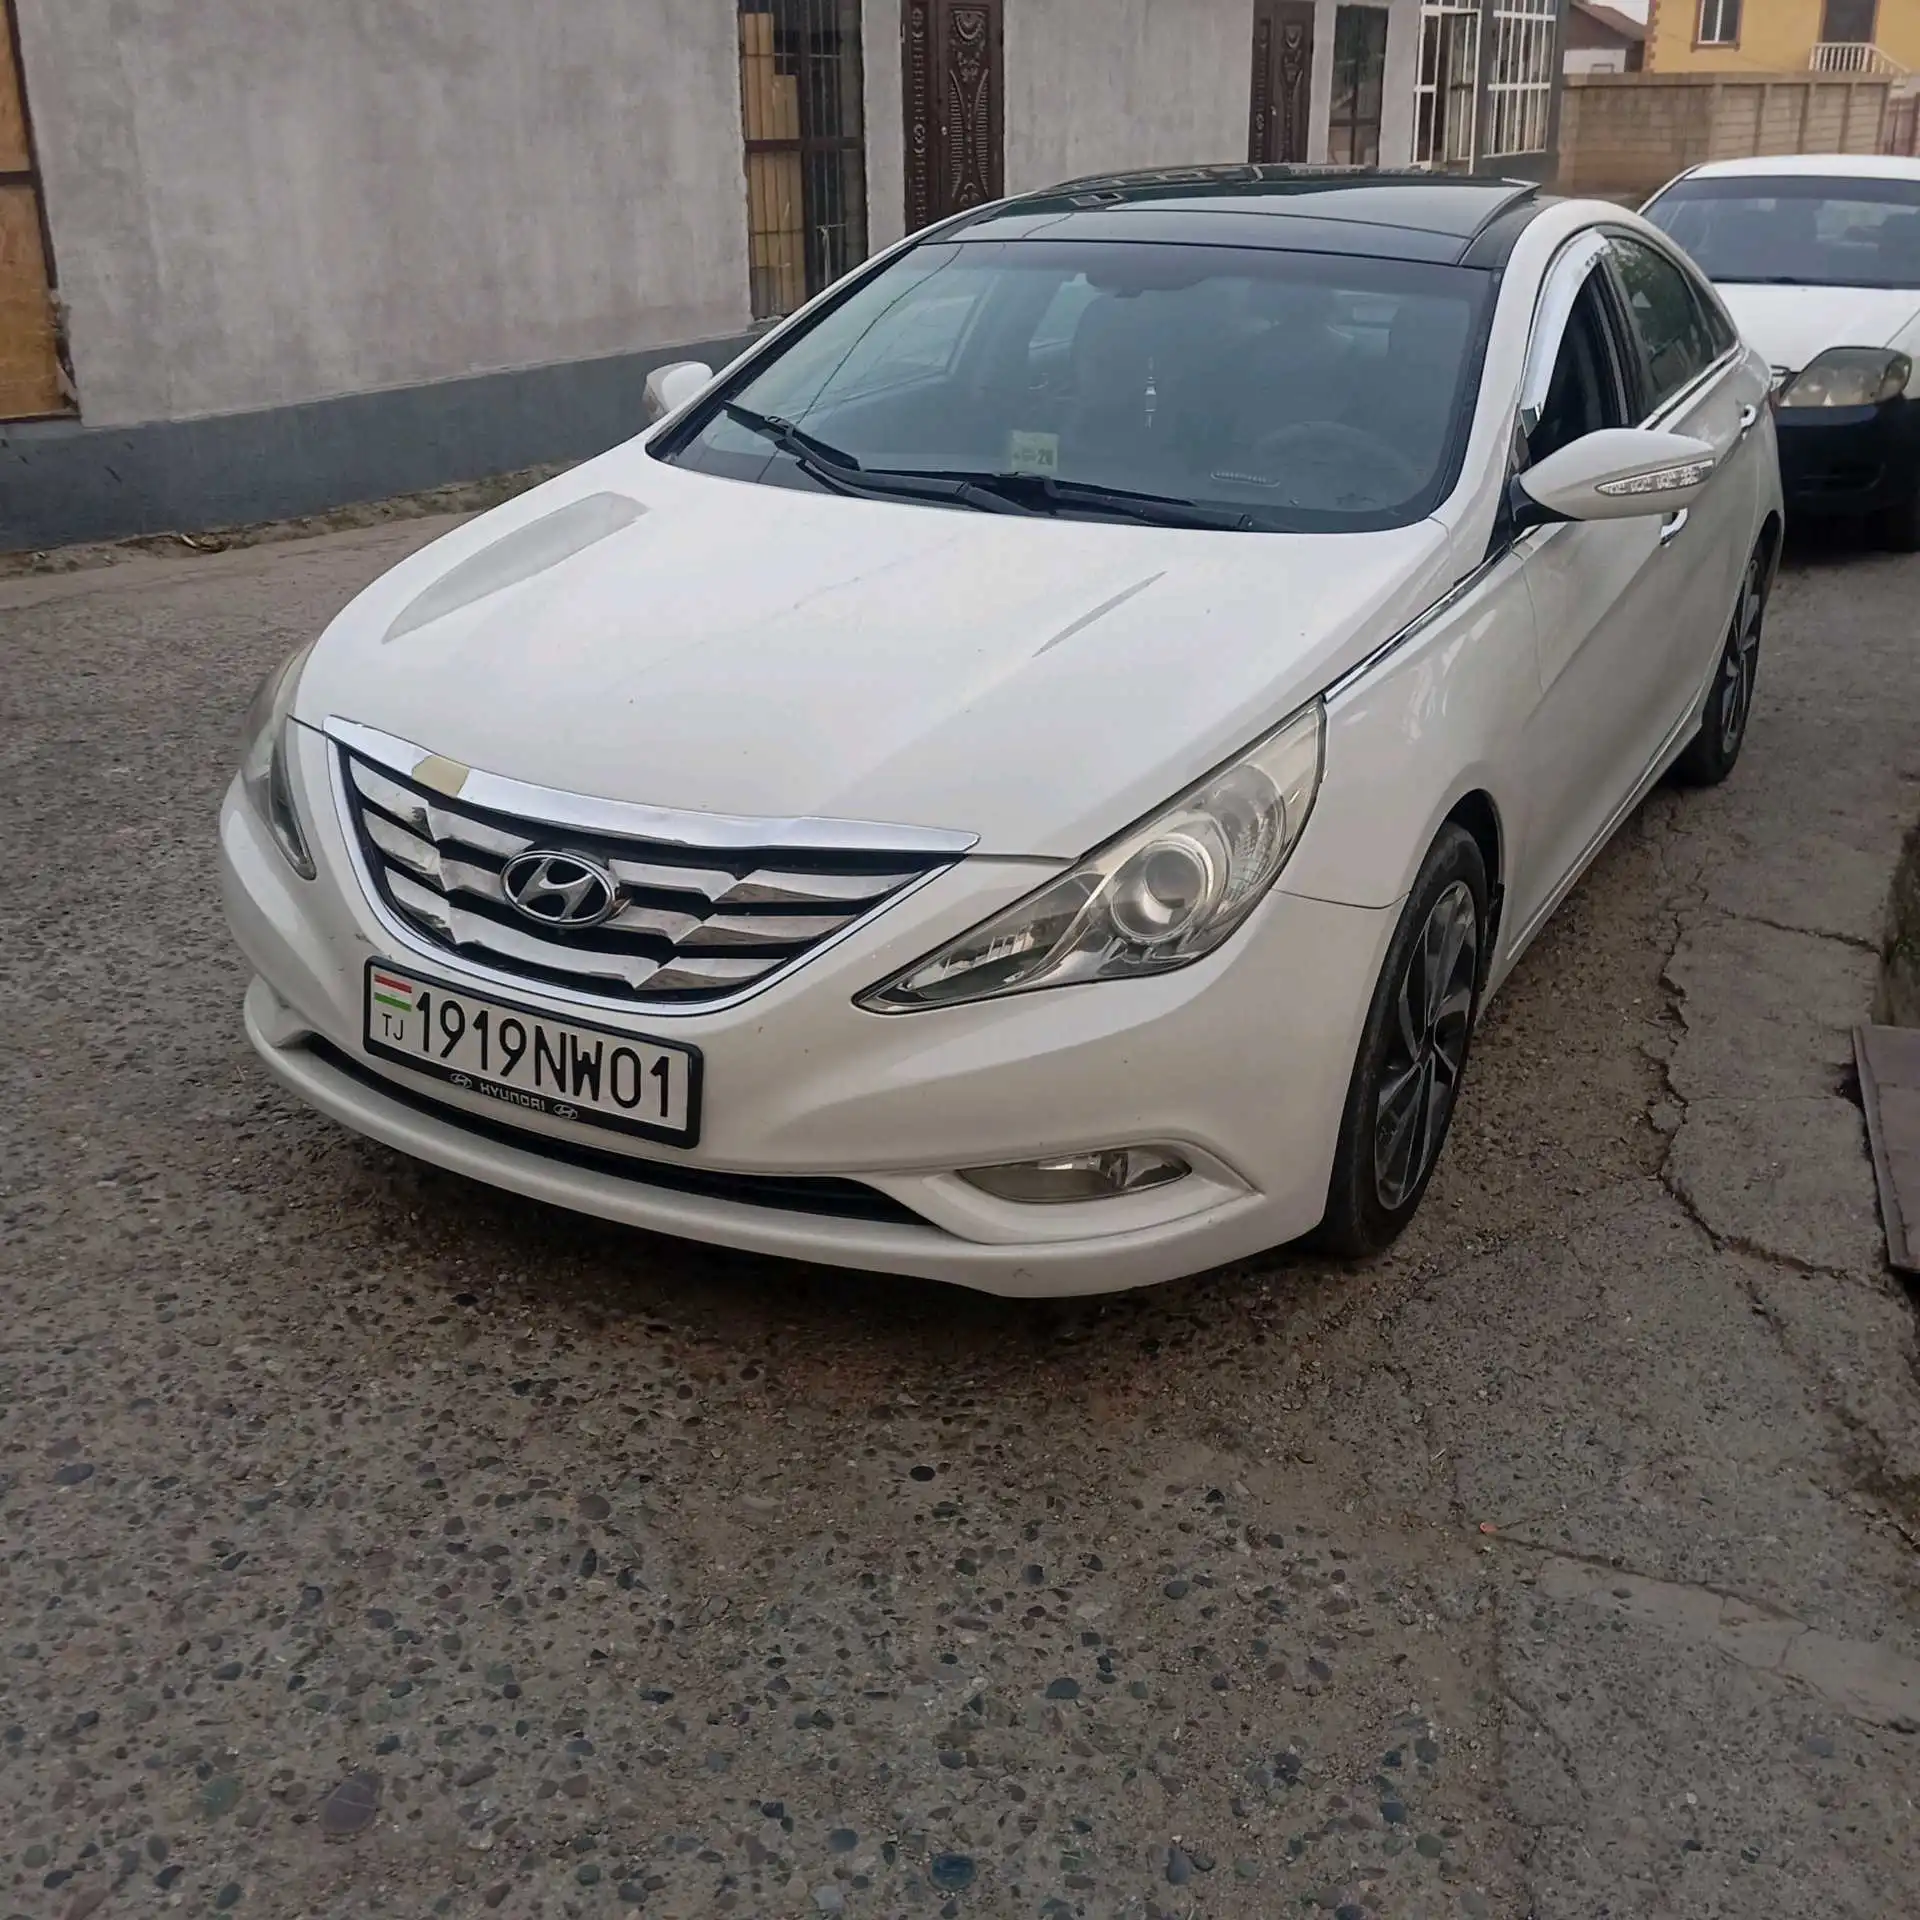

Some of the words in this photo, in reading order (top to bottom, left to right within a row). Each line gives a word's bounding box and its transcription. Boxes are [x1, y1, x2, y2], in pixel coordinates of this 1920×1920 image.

[382, 1012, 404, 1041] TJ
[416, 991, 671, 1118] 1919NW01
[480, 1082, 545, 1112] HYUNDAI
